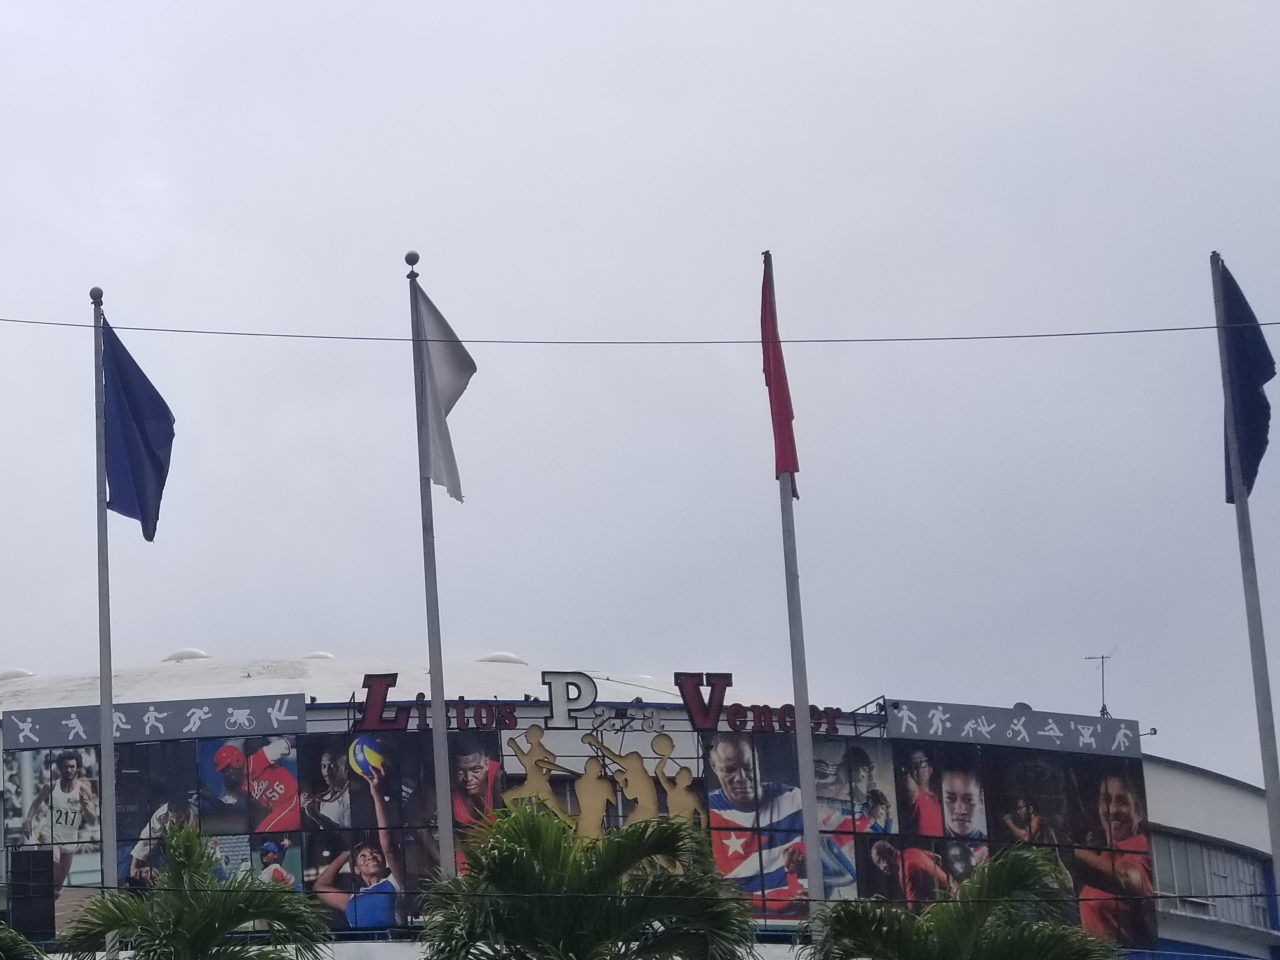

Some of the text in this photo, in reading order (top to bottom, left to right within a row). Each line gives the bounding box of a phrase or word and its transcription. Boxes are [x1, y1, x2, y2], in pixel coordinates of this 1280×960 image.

[541, 671, 665, 733] Para
[266, 781, 285, 801] 56
[55, 809, 77, 826] 217
